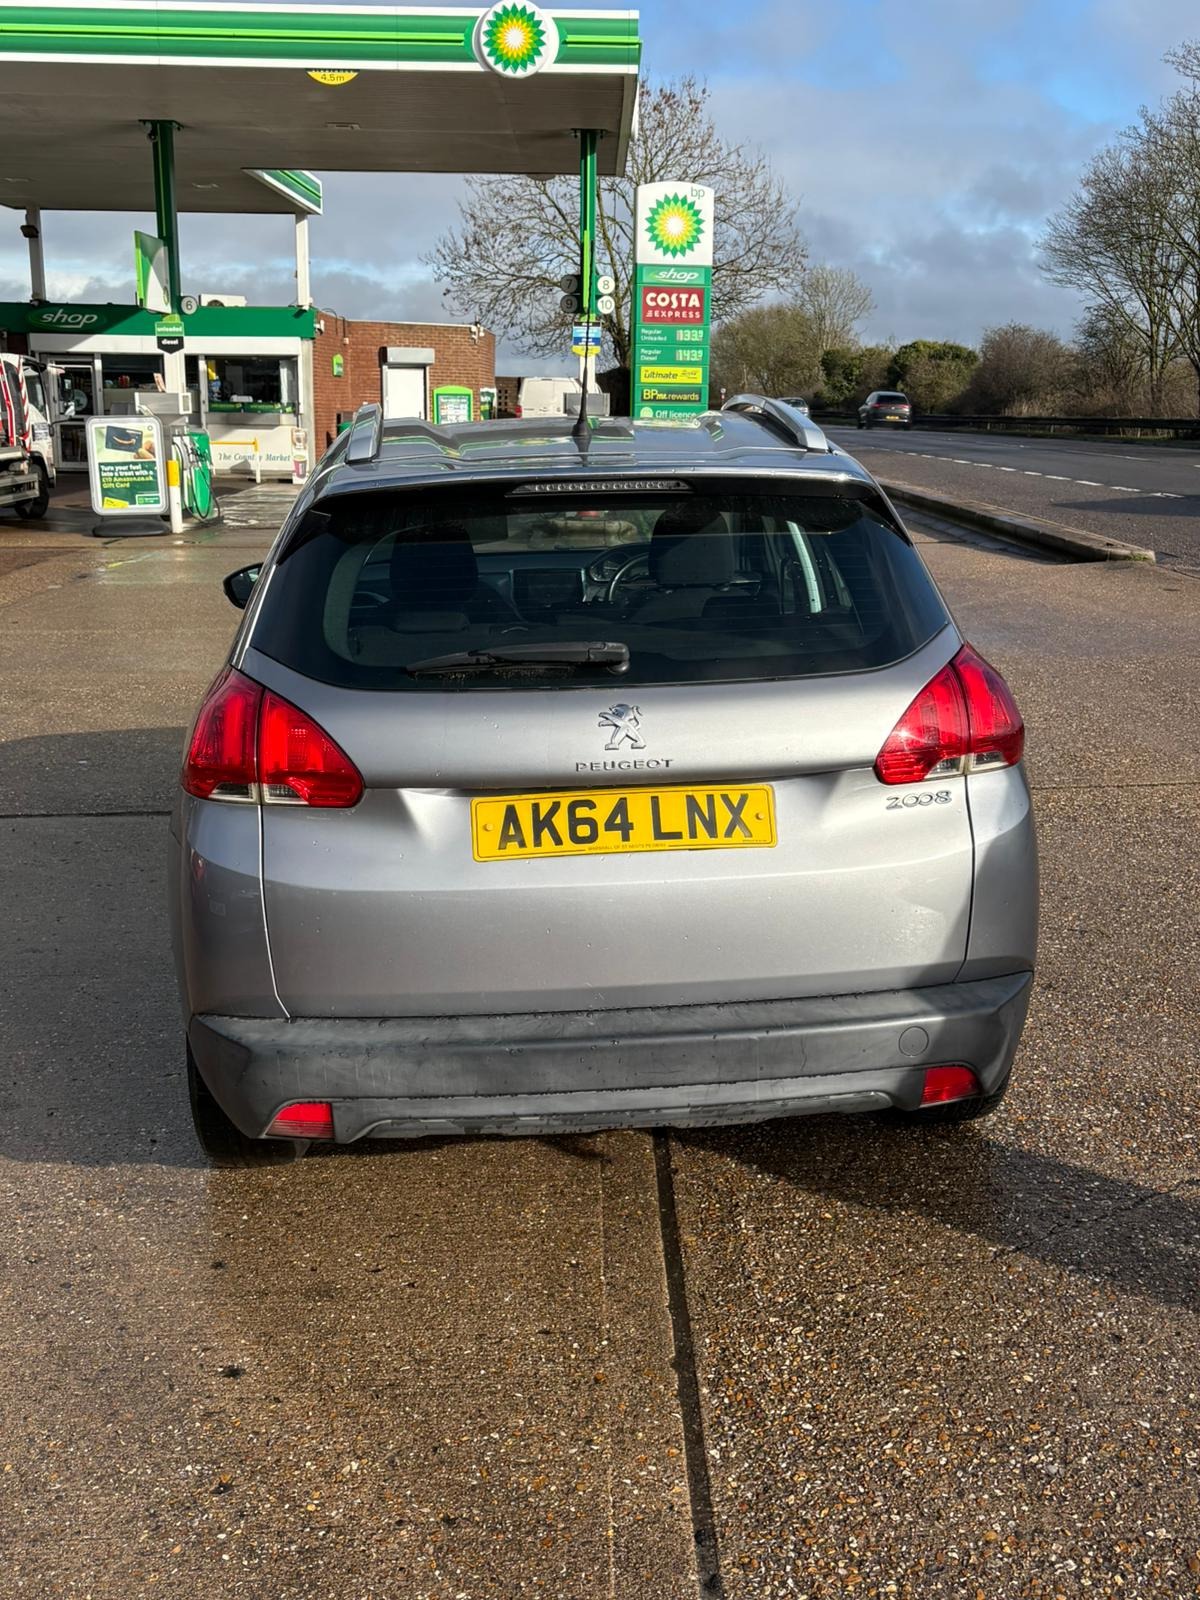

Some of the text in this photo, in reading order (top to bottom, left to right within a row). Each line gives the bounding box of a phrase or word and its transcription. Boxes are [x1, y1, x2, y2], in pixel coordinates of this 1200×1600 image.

[690, 187, 705, 199] bp
[655, 267, 699, 283] shop
[566, 279, 573, 290] 7
[603, 280, 609, 290] 8
[185, 300, 193, 311] 6
[565, 299, 572, 309] 9
[601, 300, 612, 310] 10
[645, 292, 701, 309] COSTA
[42, 308, 98, 328] shop
[654, 310, 701, 318] EXPRESS
[218, 452, 232, 461] The
[266, 453, 291, 461] Market
[575, 758, 674, 772] PEUGEOT
[885, 790, 952, 810] 2008
[498, 793, 753, 850] AK64 LNX
